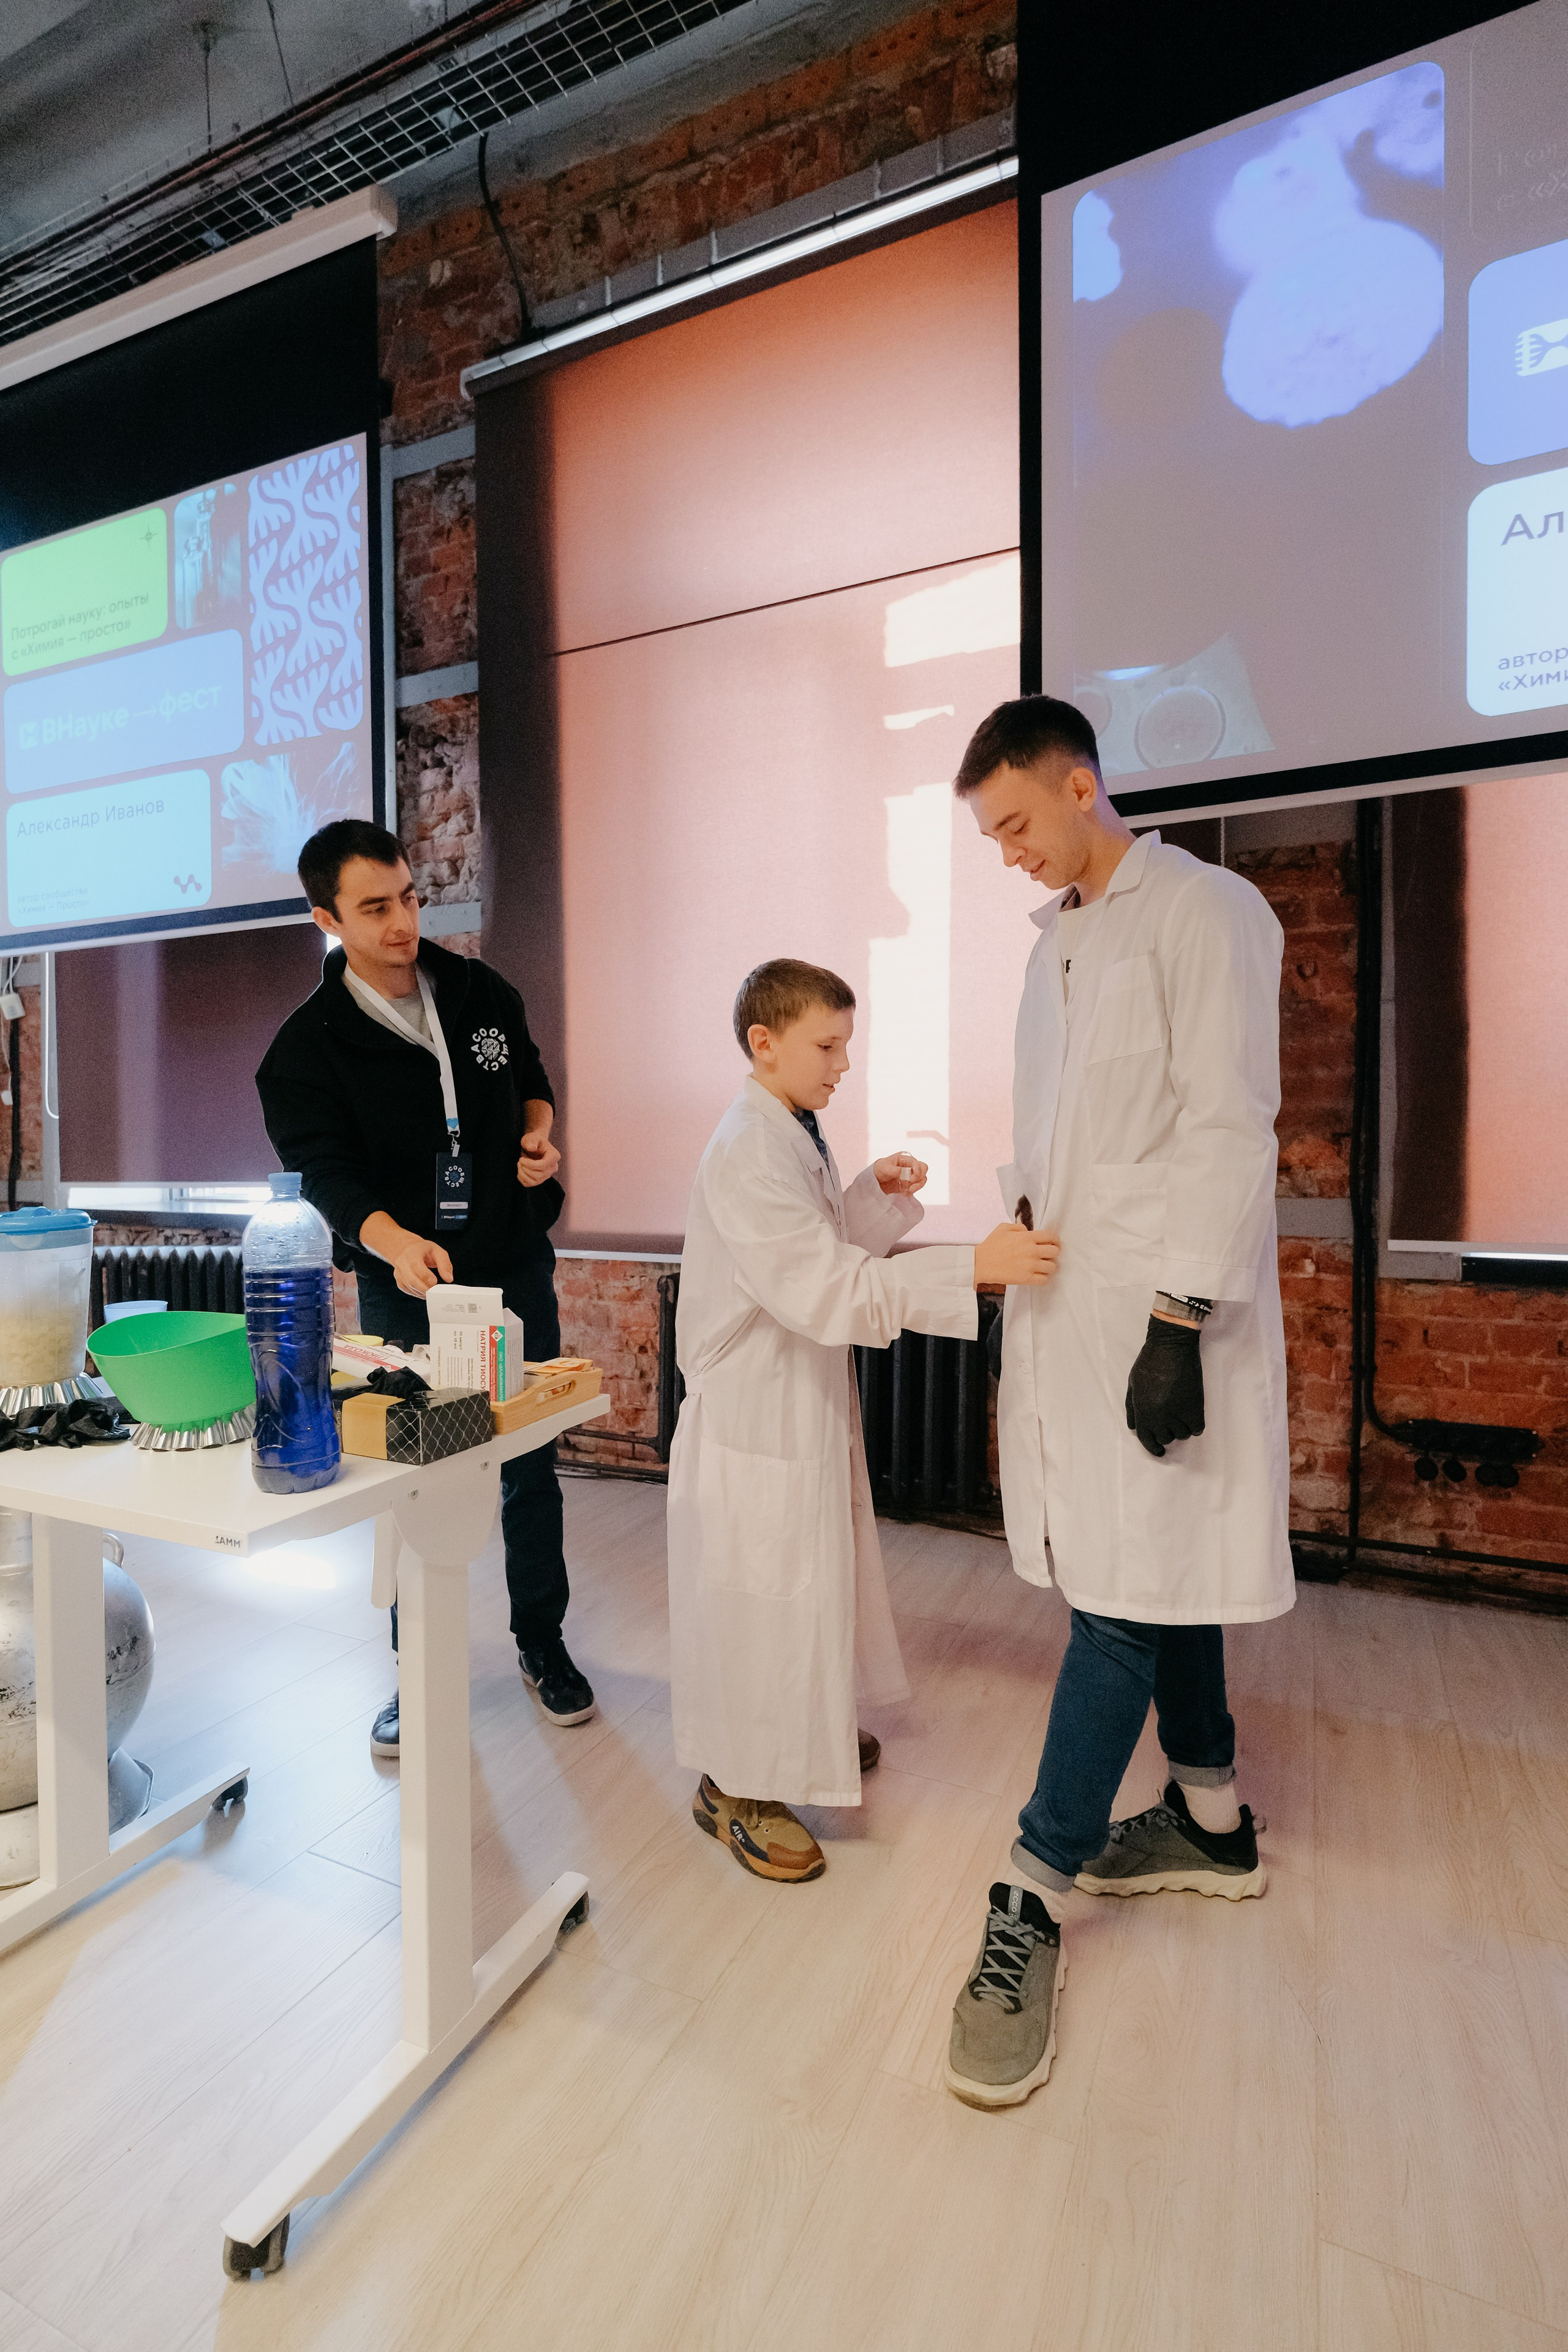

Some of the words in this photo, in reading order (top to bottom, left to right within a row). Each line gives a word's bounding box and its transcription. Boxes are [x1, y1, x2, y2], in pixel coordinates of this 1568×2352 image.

[1500, 511, 1564, 546] Ал
[12, 615, 66, 641] Потрогай
[69, 604, 106, 625] науку:
[109, 593, 149, 614] опыты
[12, 649, 18, 660] с
[21, 637, 64, 657] «Химия
[80, 619, 131, 644] просто»
[1498, 647, 1568, 670] автор
[42, 707, 129, 745] ВНауке
[159, 685, 222, 724] фест
[17, 811, 99, 837] Александр
[105, 800, 164, 822] Иванов
[17, 894, 39, 903] автор
[41, 888, 88, 900] сообщества
[344, 1344, 388, 1361] ГЛЮКОЗА
